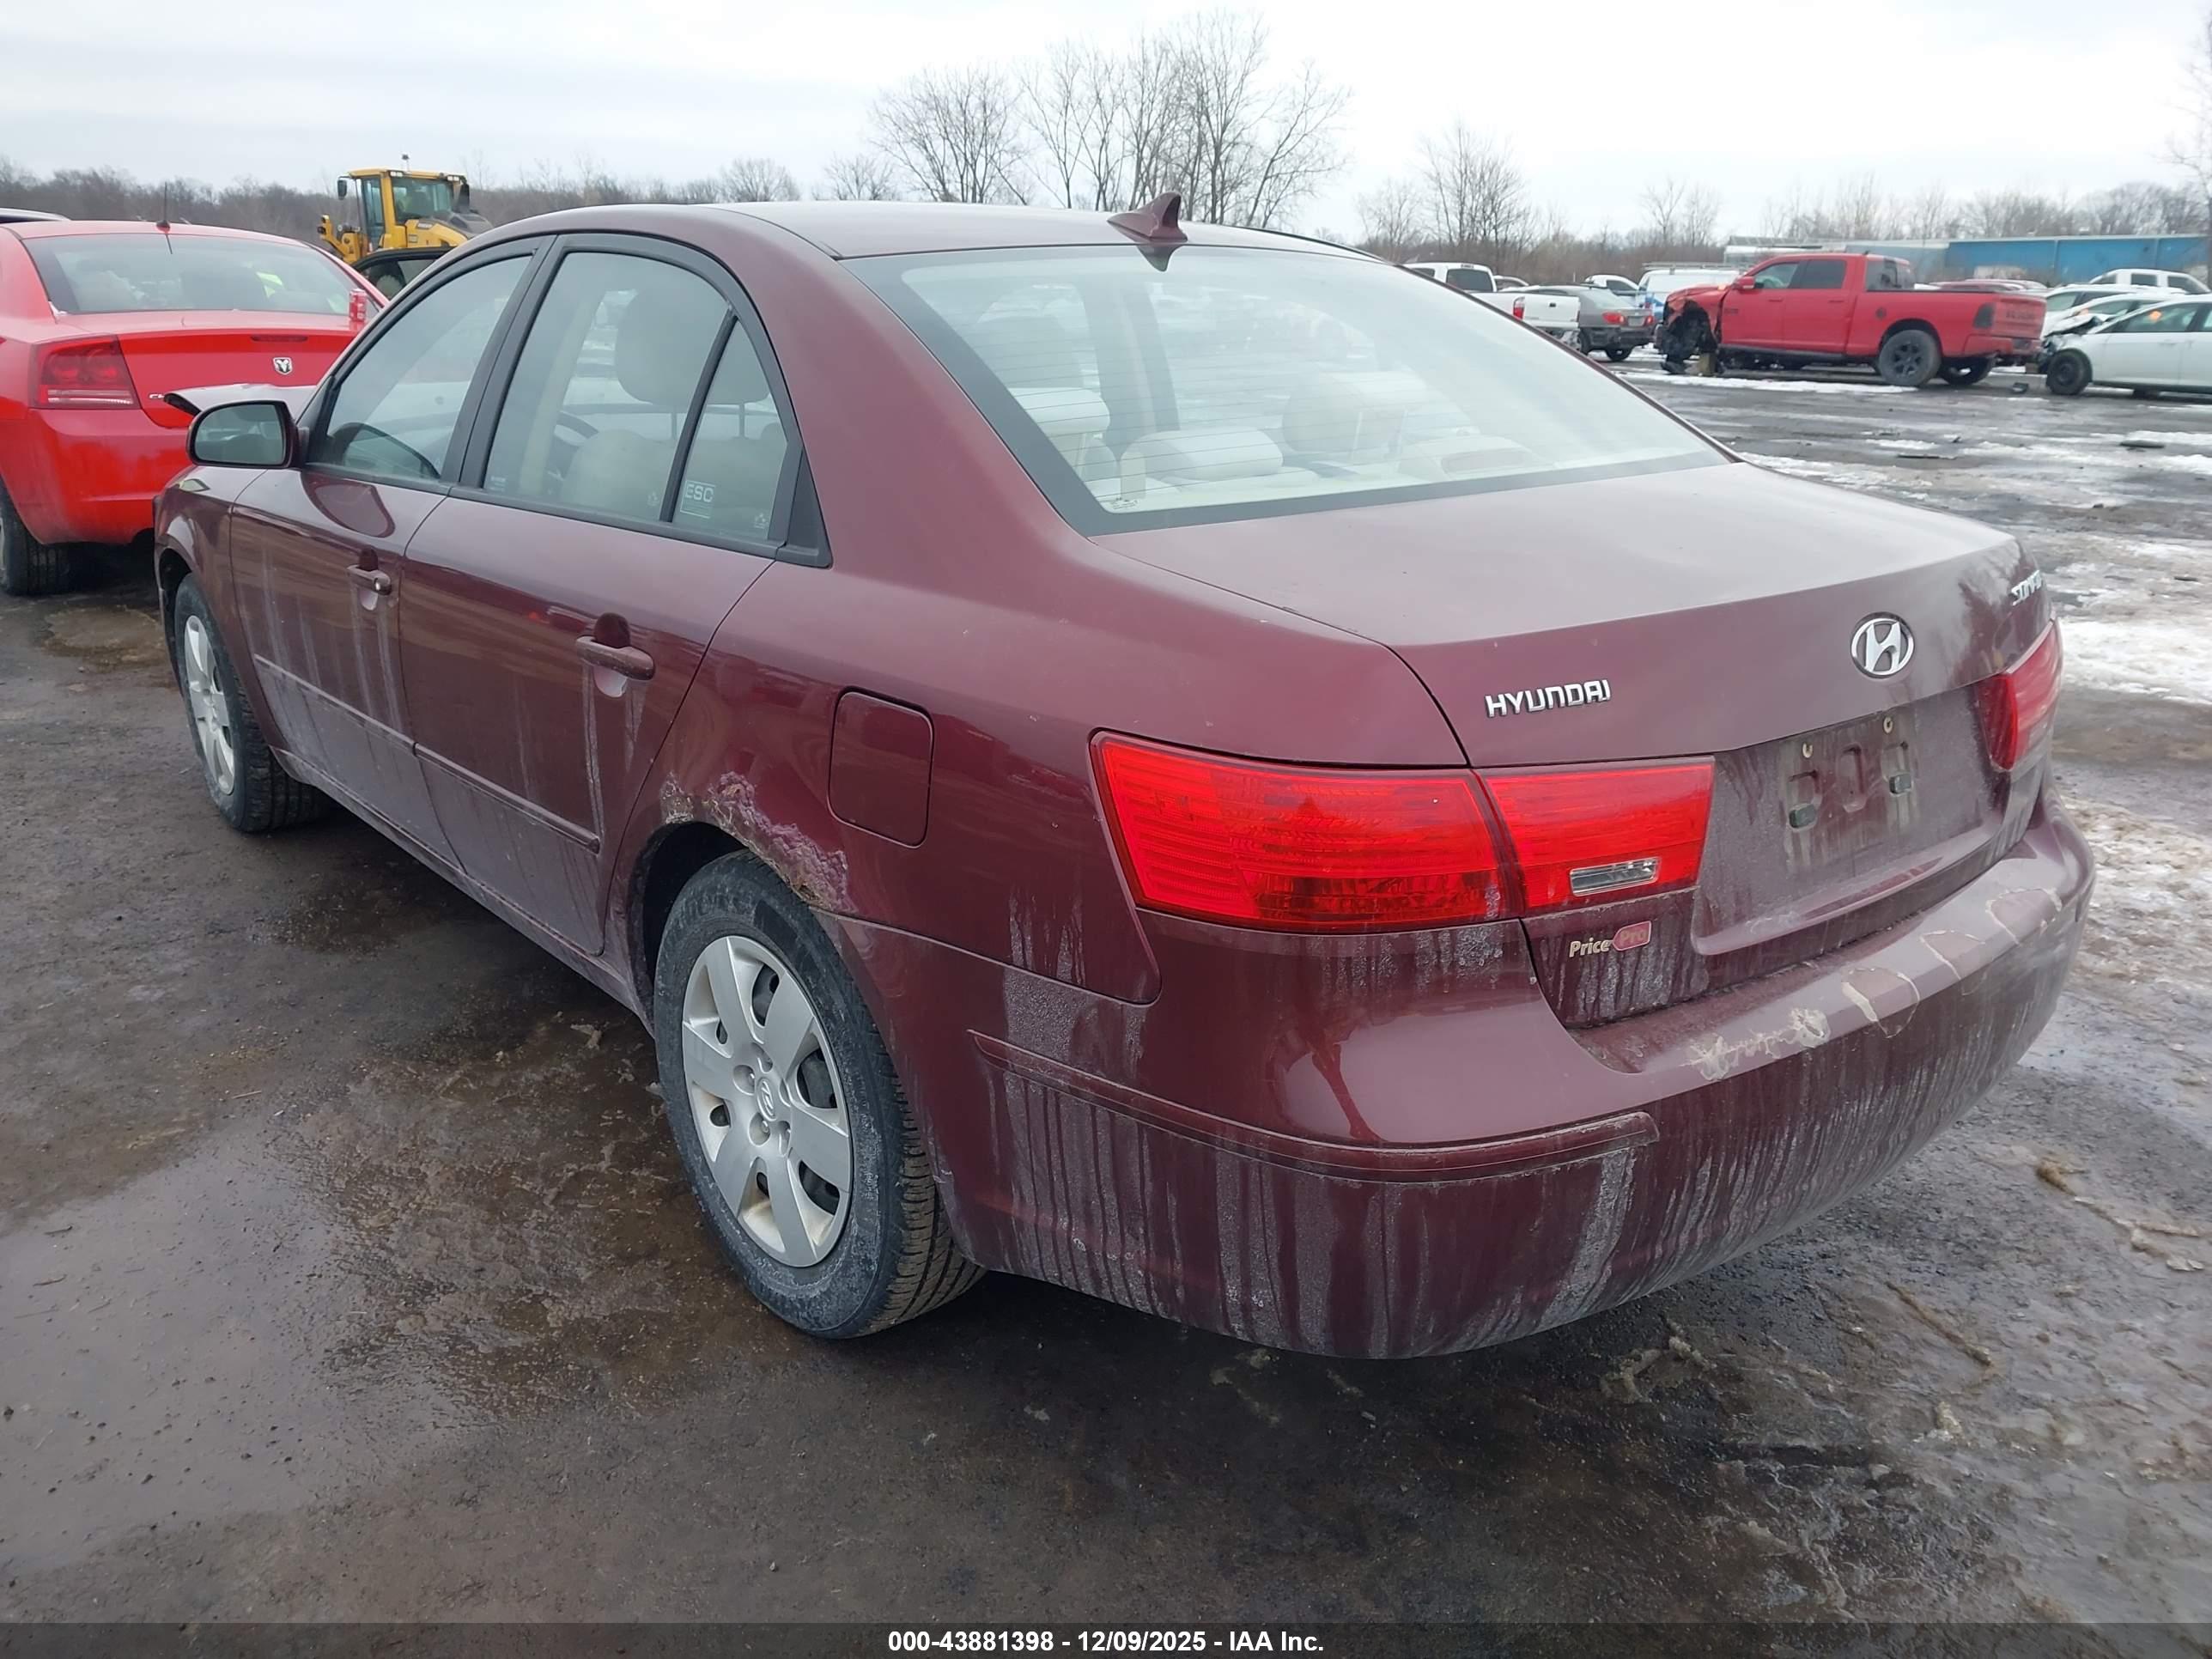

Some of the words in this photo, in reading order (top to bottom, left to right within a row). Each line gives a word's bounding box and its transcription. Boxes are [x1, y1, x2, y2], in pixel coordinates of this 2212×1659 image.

[684, 483, 714, 502] ESC
[1485, 679, 1611, 718] HYUNDAI
[1569, 937, 1612, 957] Price
[1620, 929, 1648, 947] Pro
